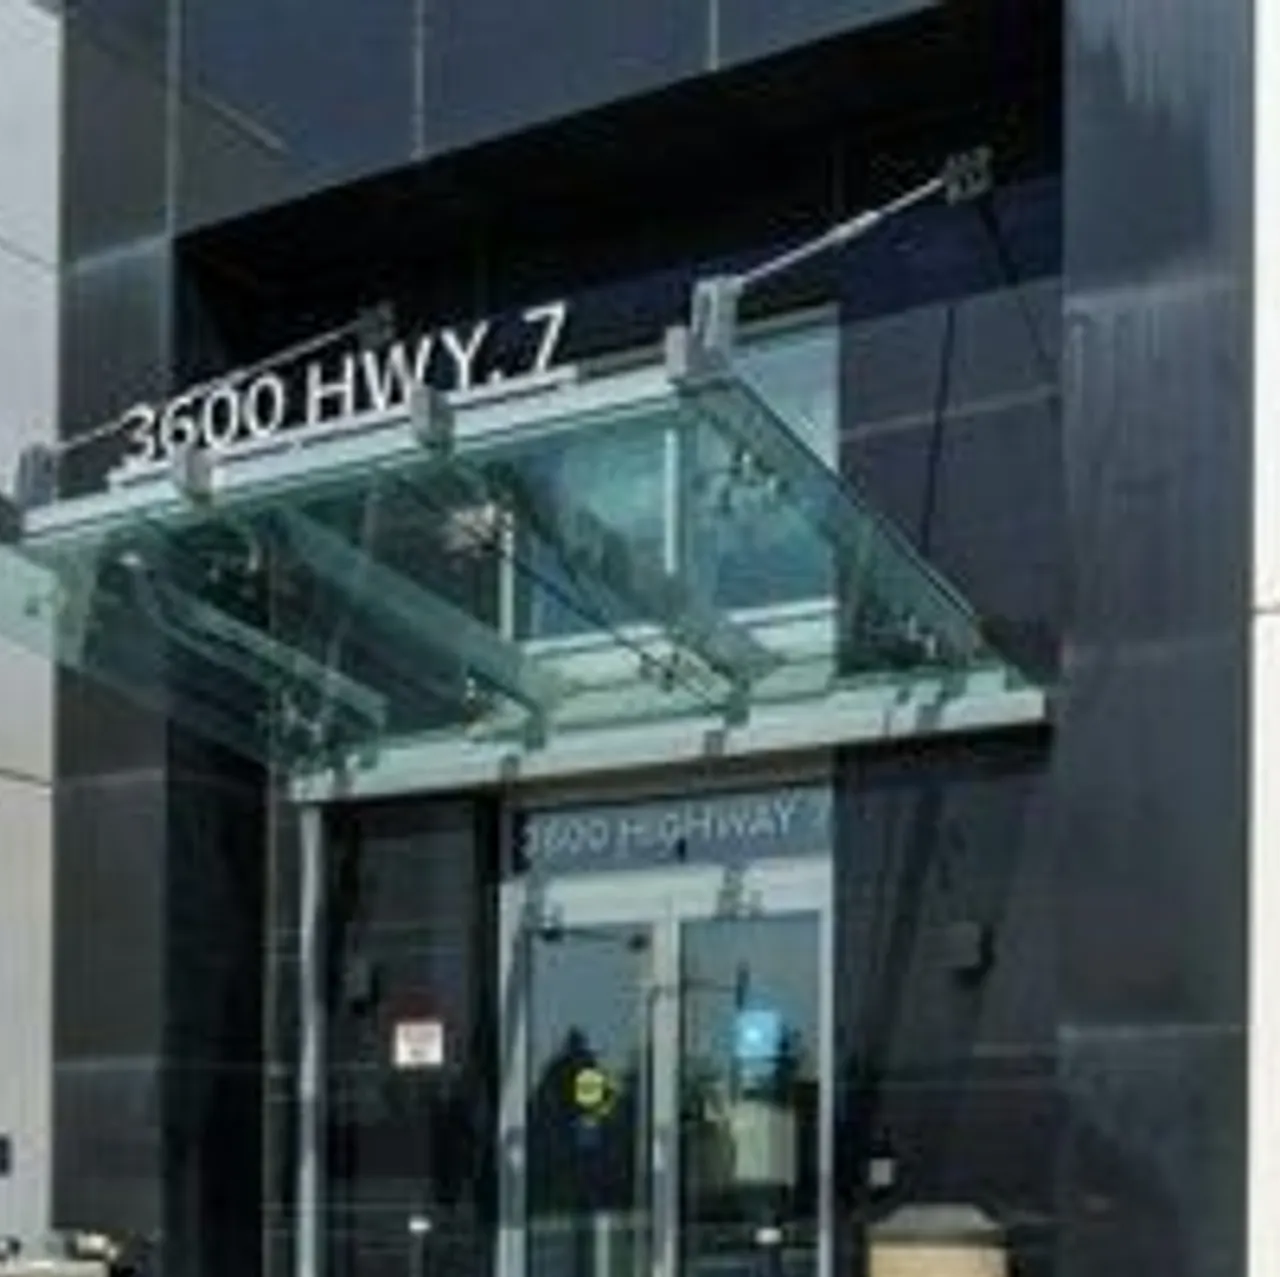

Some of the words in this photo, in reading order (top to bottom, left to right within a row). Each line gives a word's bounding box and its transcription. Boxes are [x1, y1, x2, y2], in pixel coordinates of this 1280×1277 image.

[121, 374, 285, 464] 3600
[306, 318, 502, 428] HWY.
[523, 299, 567, 374] 7
[619, 793, 798, 860] HGHWAY
